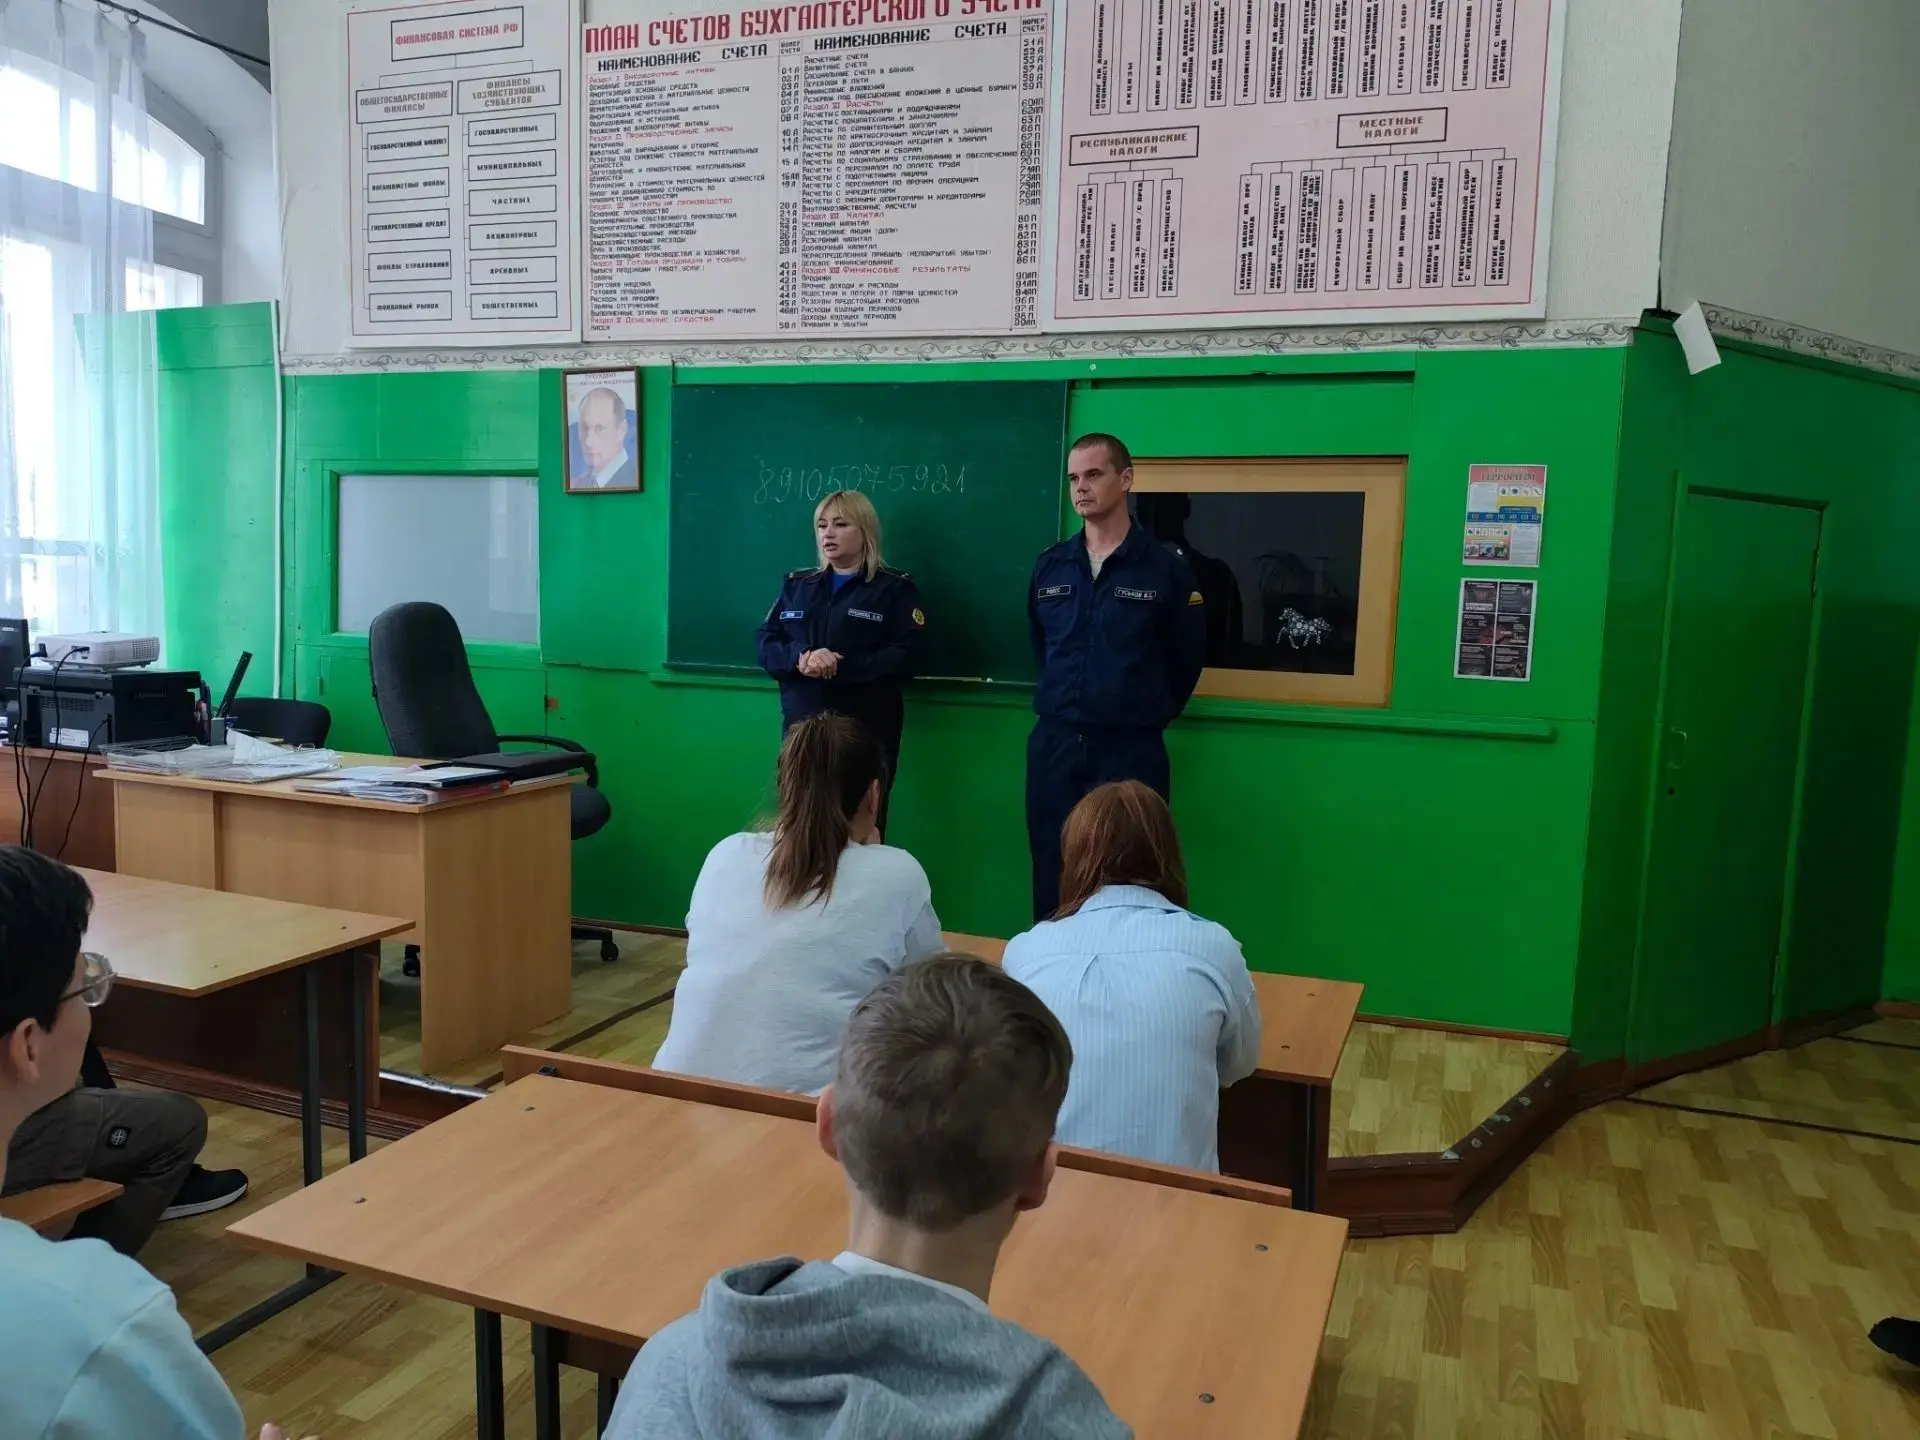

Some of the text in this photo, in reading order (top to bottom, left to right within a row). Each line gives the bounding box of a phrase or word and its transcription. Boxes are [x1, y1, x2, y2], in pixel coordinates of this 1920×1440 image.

[585, 24, 639, 54] ПЛАН
[649, 14, 730, 46] СЧЕТОВ
[741, 0, 949, 37] БУХГАЛТЕРСКОГО
[1022, 25, 1045, 33] СЧЕТА
[395, 23, 518, 45] ФИНАНСОВАЯ СИСТЕМА РФ
[814, 22, 1007, 50] НАИМЕНОВАНИЕ СЧЕТА
[598, 44, 767, 72] НАИМЕНОВАНИЕ СЧЕТА
[487, 78, 530, 89] ФИНАНСЫ
[472, 85, 546, 99] ХОЗЯЙСТВУЮЩИХ
[360, 91, 448, 106] ОБЩЕГОСУДАРСТВЕННЫЕ
[484, 96, 532, 107] СУБЪЕКТОВ
[384, 103, 425, 113] ФИНАНСЫ
[1359, 115, 1424, 128] МЕСТНЫЕ
[1364, 126, 1419, 138] НАЛОГИ
[1080, 132, 1188, 148] РЕСПУБЛИКАНСКИЕ
[1109, 145, 1158, 156] НАЛОГИ
[477, 160, 542, 171] МУНИЦИПАЛЬНЫХ
[492, 197, 531, 205] ЧАСТНЫХ
[490, 267, 529, 275] АРЕНДНЫХ
[754, 463, 965, 504] 89105075921
